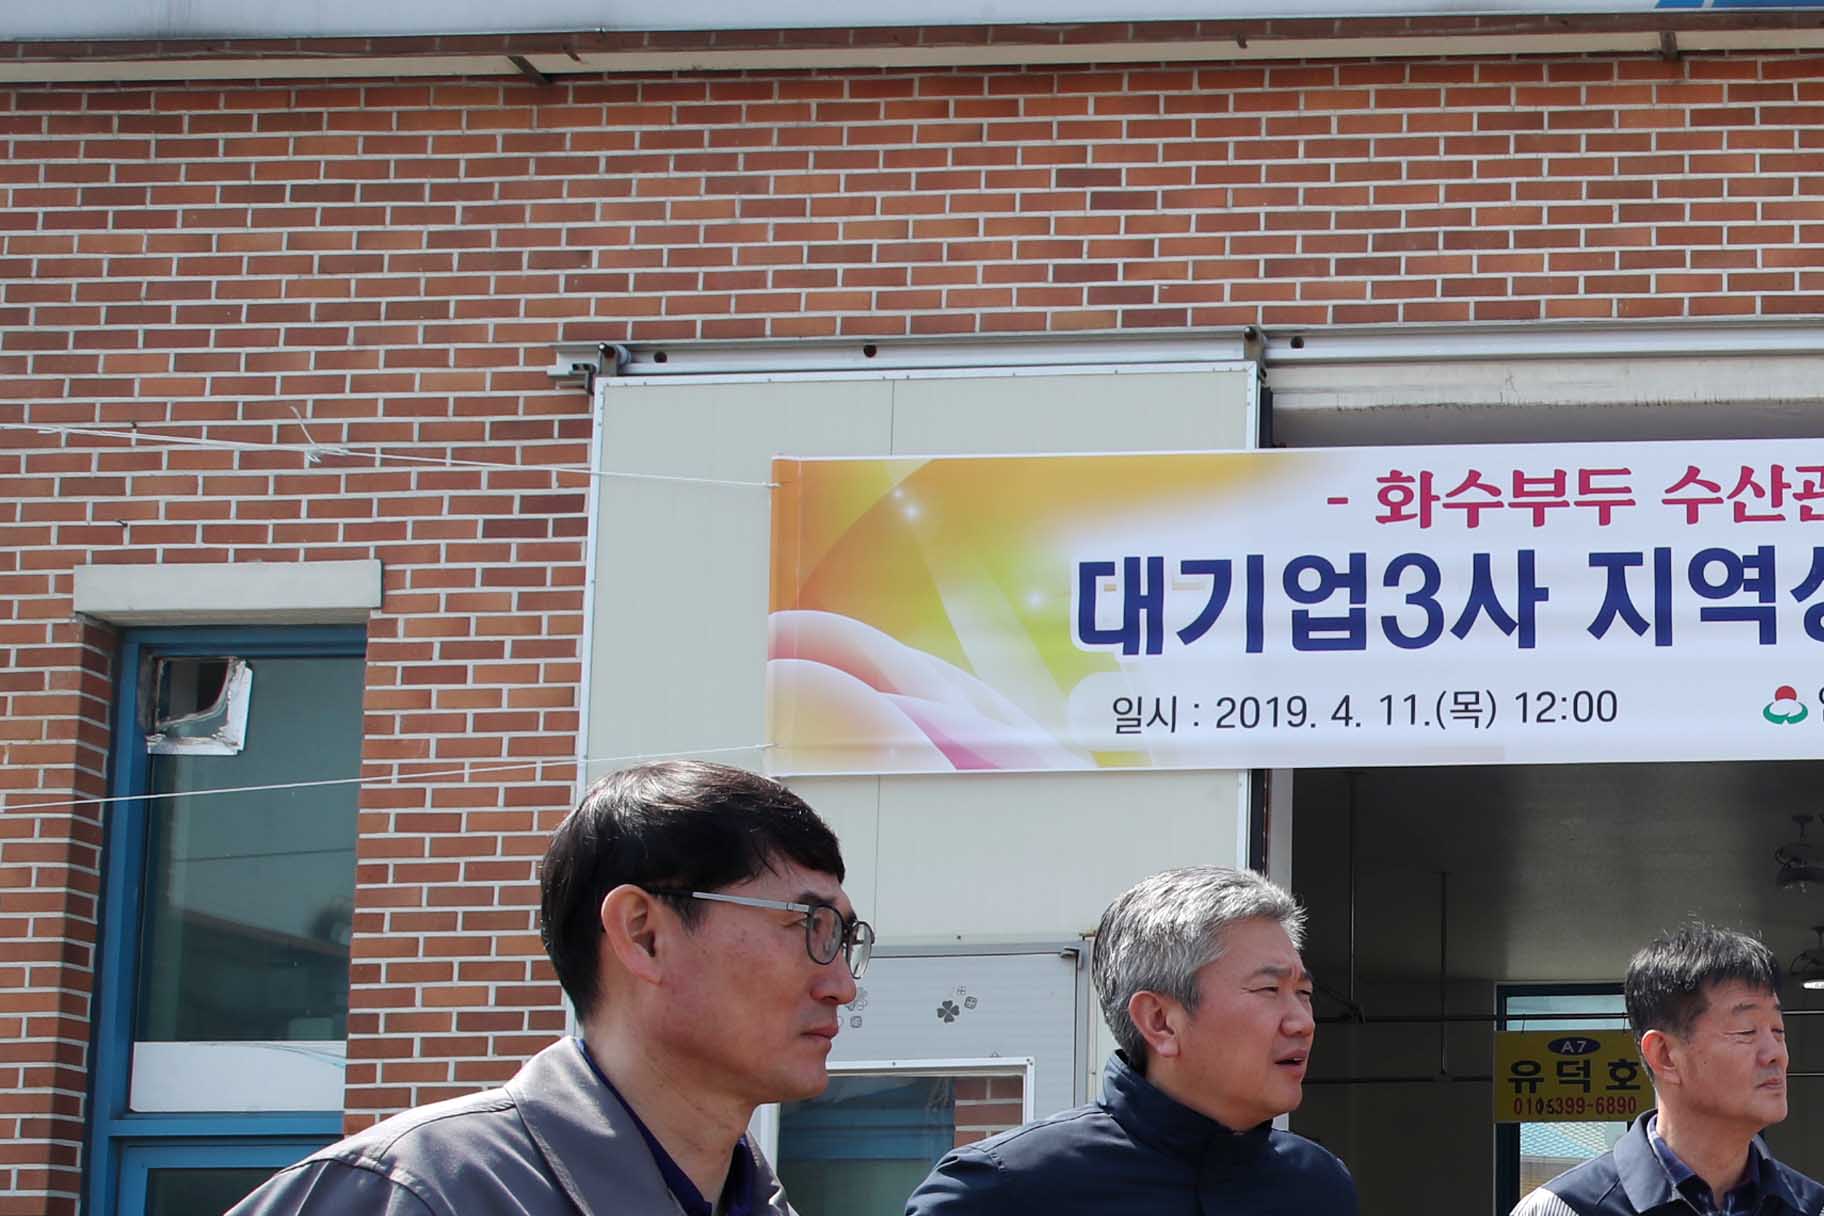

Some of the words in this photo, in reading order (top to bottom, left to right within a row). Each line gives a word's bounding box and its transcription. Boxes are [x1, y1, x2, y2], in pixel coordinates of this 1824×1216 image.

[1376, 468, 1636, 528] 화수부두
[1076, 550, 1549, 657] 대기업3사
[1112, 695, 1177, 734] 일시
[1216, 695, 1316, 729] 2019.
[1331, 694, 1361, 728] 4.
[1379, 689, 1497, 730] 11.(목)
[1515, 689, 1618, 724] 12:00
[1507, 1059, 1641, 1094] 유덕호
